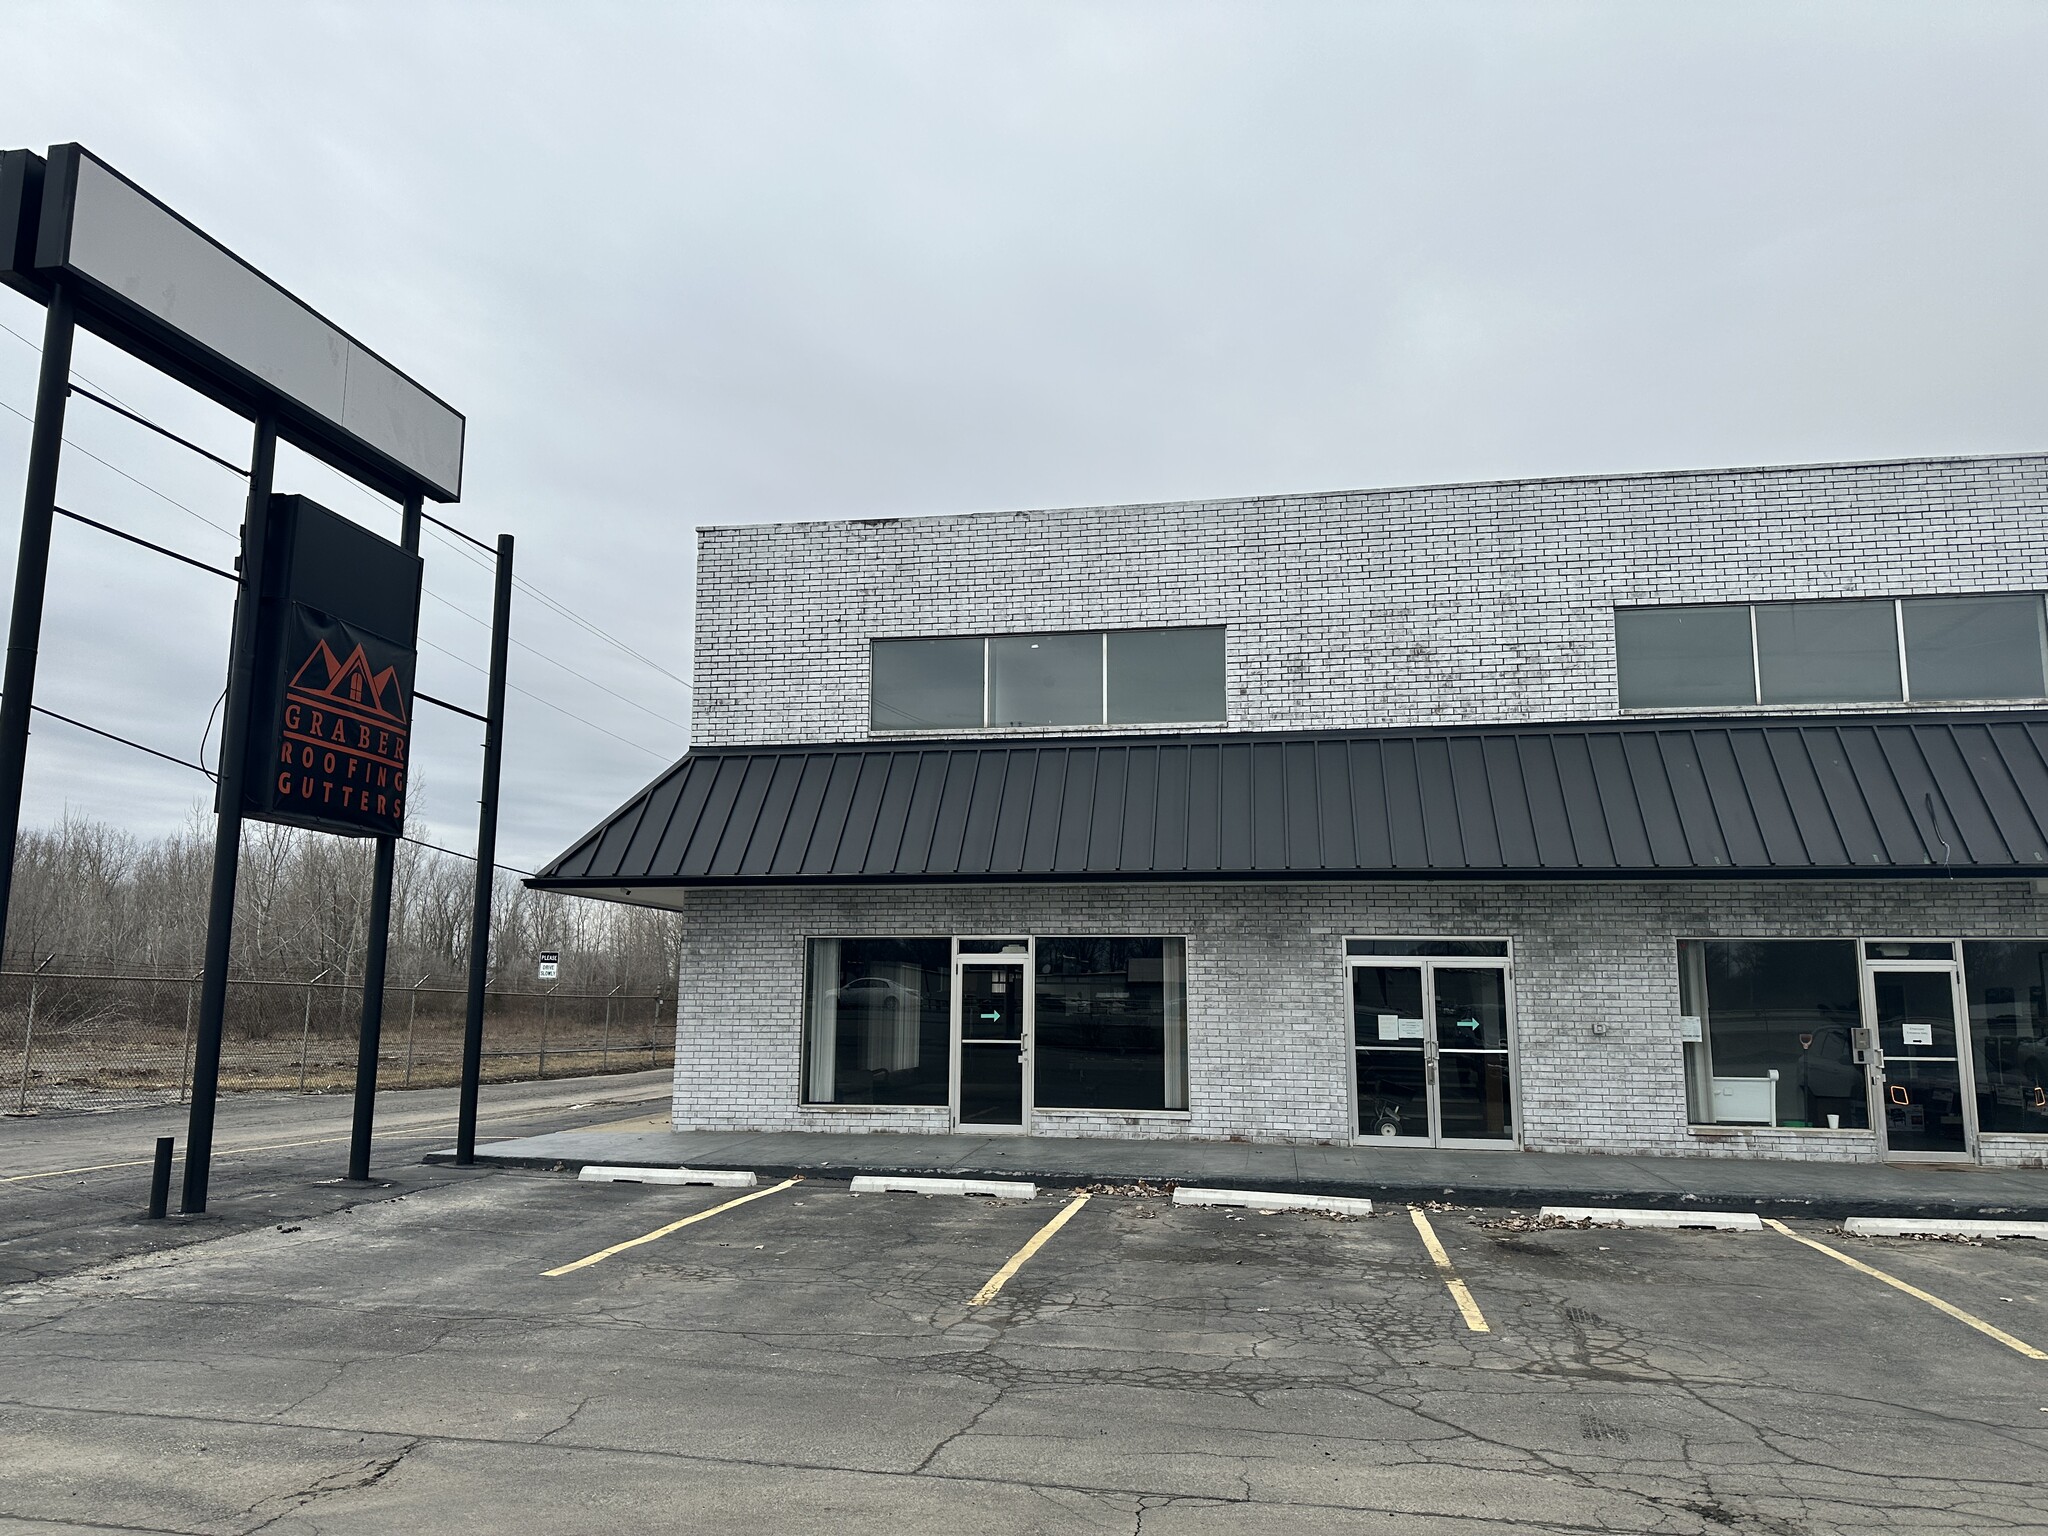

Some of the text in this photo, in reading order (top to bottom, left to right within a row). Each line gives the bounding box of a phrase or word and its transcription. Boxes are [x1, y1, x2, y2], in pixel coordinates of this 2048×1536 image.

[285, 704, 405, 761] GRABER
[281, 741, 403, 791] ROOFING
[278, 772, 401, 818] GUTTERS
